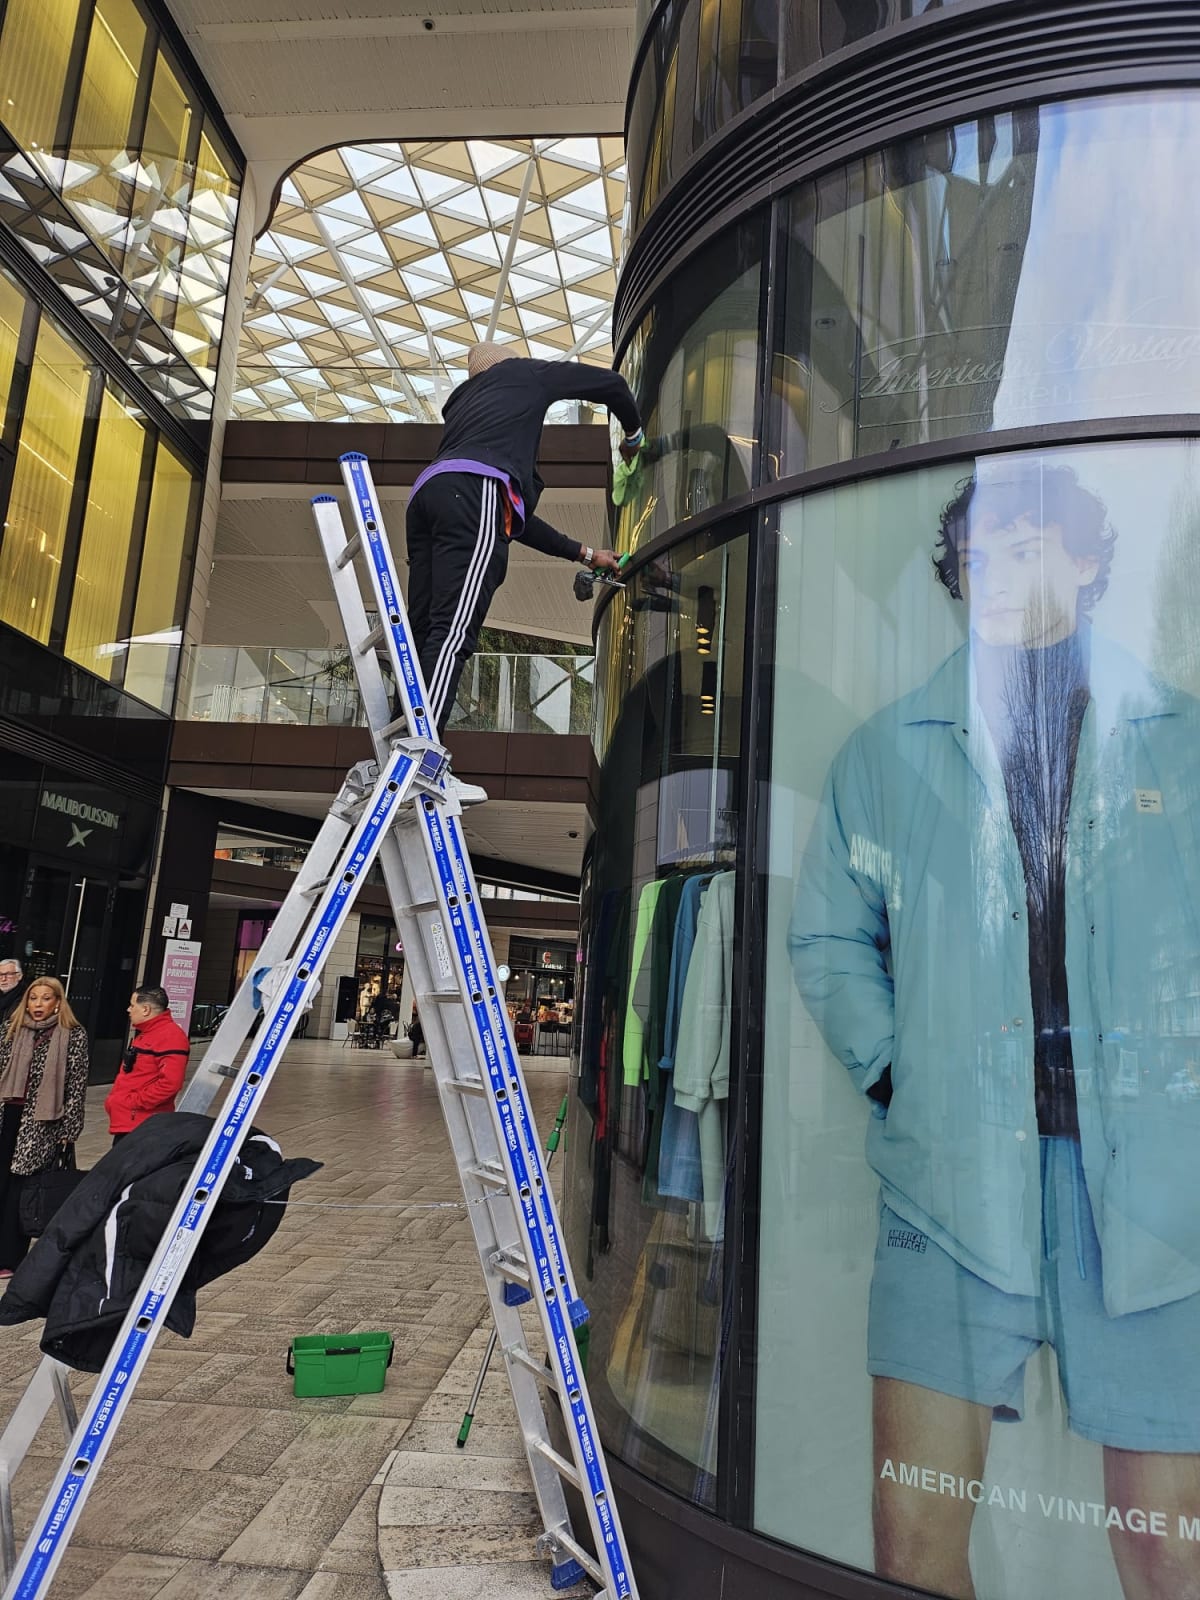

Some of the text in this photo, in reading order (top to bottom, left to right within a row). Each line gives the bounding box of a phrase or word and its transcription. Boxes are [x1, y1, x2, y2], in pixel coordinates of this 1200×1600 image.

[363, 508, 378, 542] TUCA
[380, 570, 394, 604] TUBESCA
[401, 652, 415, 685] TUBESCA
[41, 790, 119, 830] MAUBOUSSIN
[429, 817, 443, 851] TUBESCA
[338, 861, 359, 896] TUCA
[306, 924, 328, 962] TUBESCA
[166, 968, 195, 978] PARKING
[264, 1012, 287, 1051] TUBESCA
[482, 1029, 496, 1065] TUBESCA
[230, 1085, 253, 1126] TUBESCA
[503, 1114, 518, 1151] TUBESCA
[210, 1139, 228, 1170] PLATINIUM
[888, 1229, 928, 1243] AMERICAN
[888, 1237, 928, 1254] VINTAGE
[122, 1332, 142, 1368] PLATINIUM
[557, 1336, 572, 1374] TUBESCA
[90, 1384, 120, 1437] TUBESCA
[579, 1424, 594, 1463] TUBESCA
[45, 1481, 77, 1537] TUBESCA
[879, 1458, 1026, 1513] AMERICAN
[1038, 1494, 1168, 1537] VINTAGE
[21, 1555, 44, 1598] PLATINIUM
